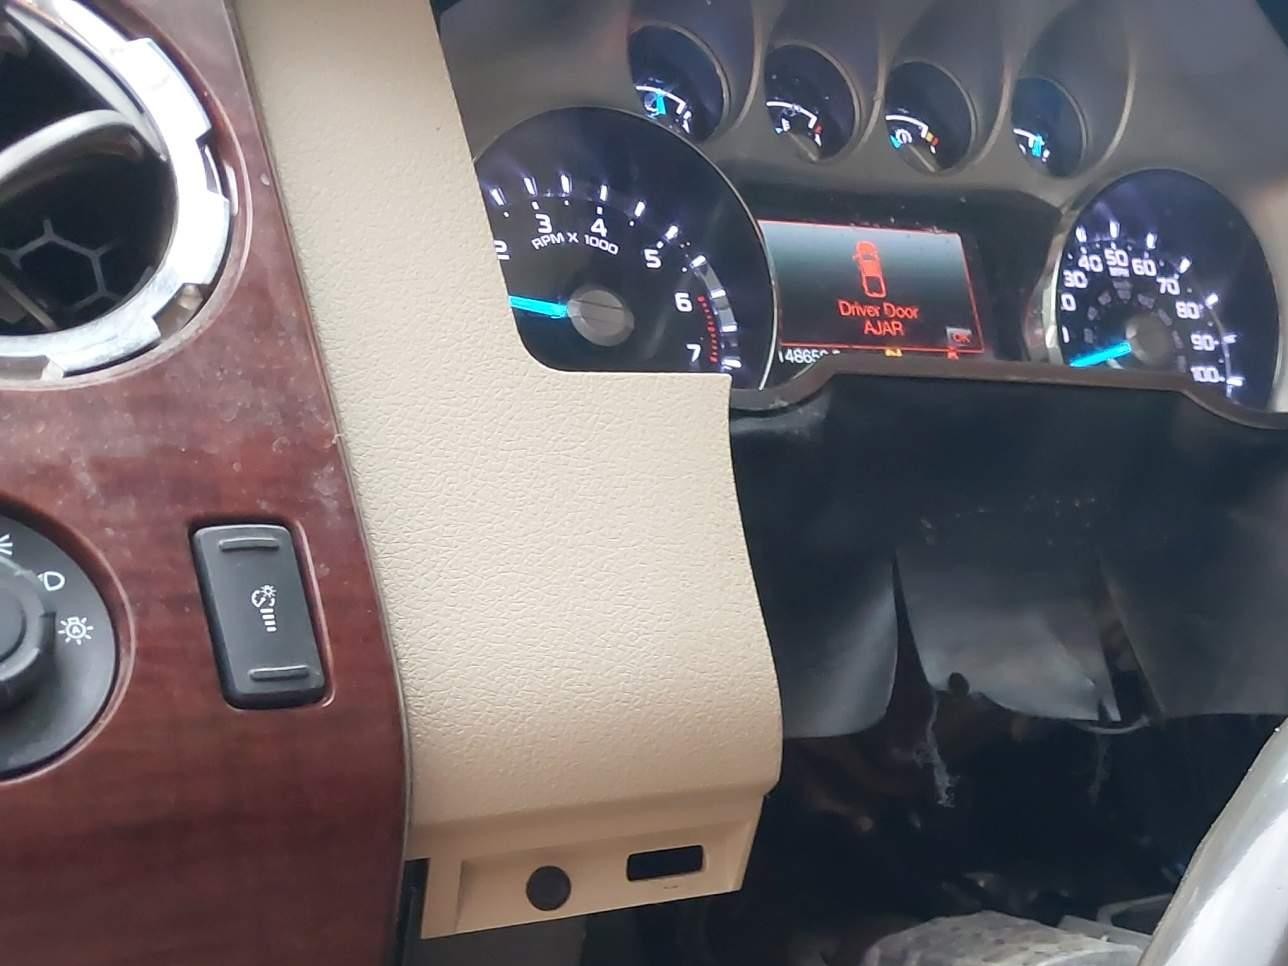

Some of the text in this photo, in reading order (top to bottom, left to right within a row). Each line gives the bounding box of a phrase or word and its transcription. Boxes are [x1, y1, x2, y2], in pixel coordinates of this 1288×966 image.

[535, 214, 552, 234] 3
[591, 218, 608, 238] 4
[531, 232, 619, 255] RPM X 1000
[644, 248, 662, 269] 5
[1078, 254, 1103, 272] 40
[1104, 249, 1129, 267] 50
[1132, 258, 1157, 277] 60
[1063, 271, 1088, 288] 30
[1157, 277, 1180, 295] 70
[675, 293, 694, 313] 6
[838, 300, 919, 319] Driver Door
[1060, 293, 1076, 311] 0
[1176, 301, 1200, 319] 80
[863, 321, 904, 336] AJAR
[1191, 334, 1215, 351] 90
[686, 344, 701, 362] 7
[1191, 366, 1220, 383] 100
